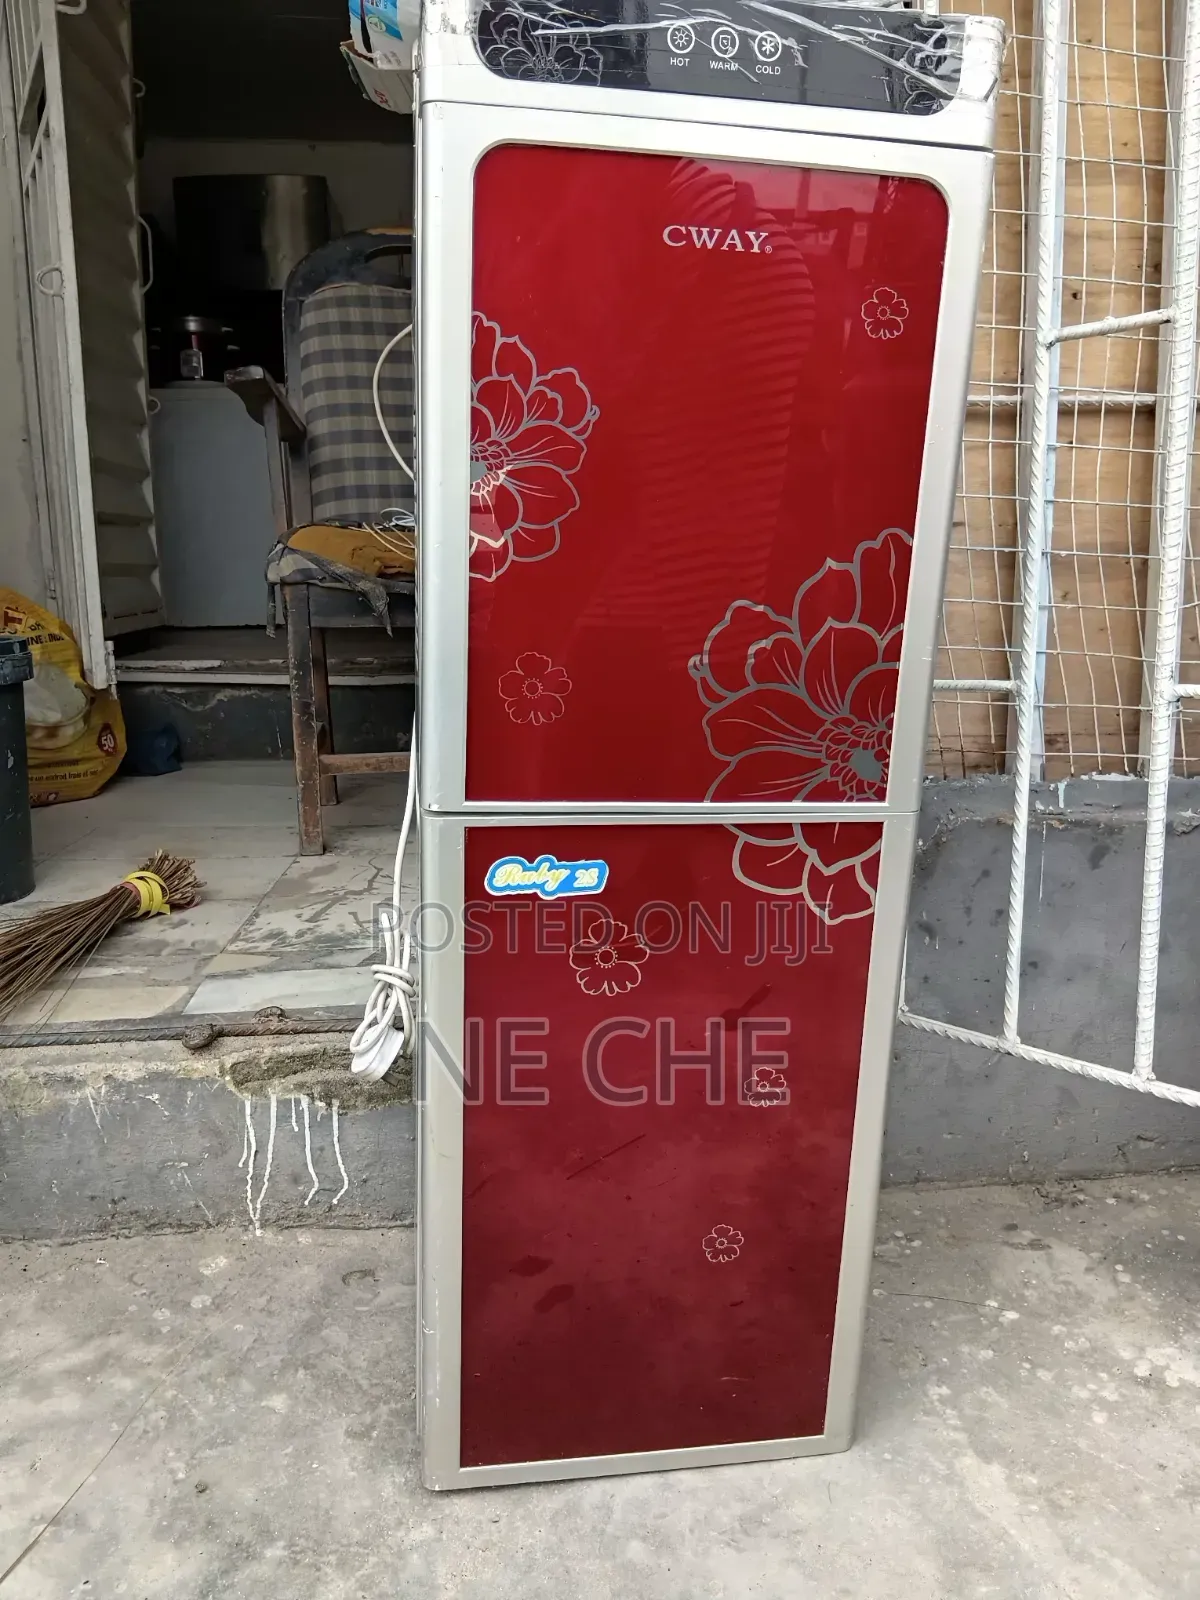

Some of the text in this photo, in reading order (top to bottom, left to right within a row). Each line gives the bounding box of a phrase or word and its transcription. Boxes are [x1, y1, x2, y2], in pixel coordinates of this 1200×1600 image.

[670, 56, 690, 67] HOT
[709, 60, 738, 71] WARM
[755, 64, 781, 75] COLD
[101, 733, 115, 751] 50
